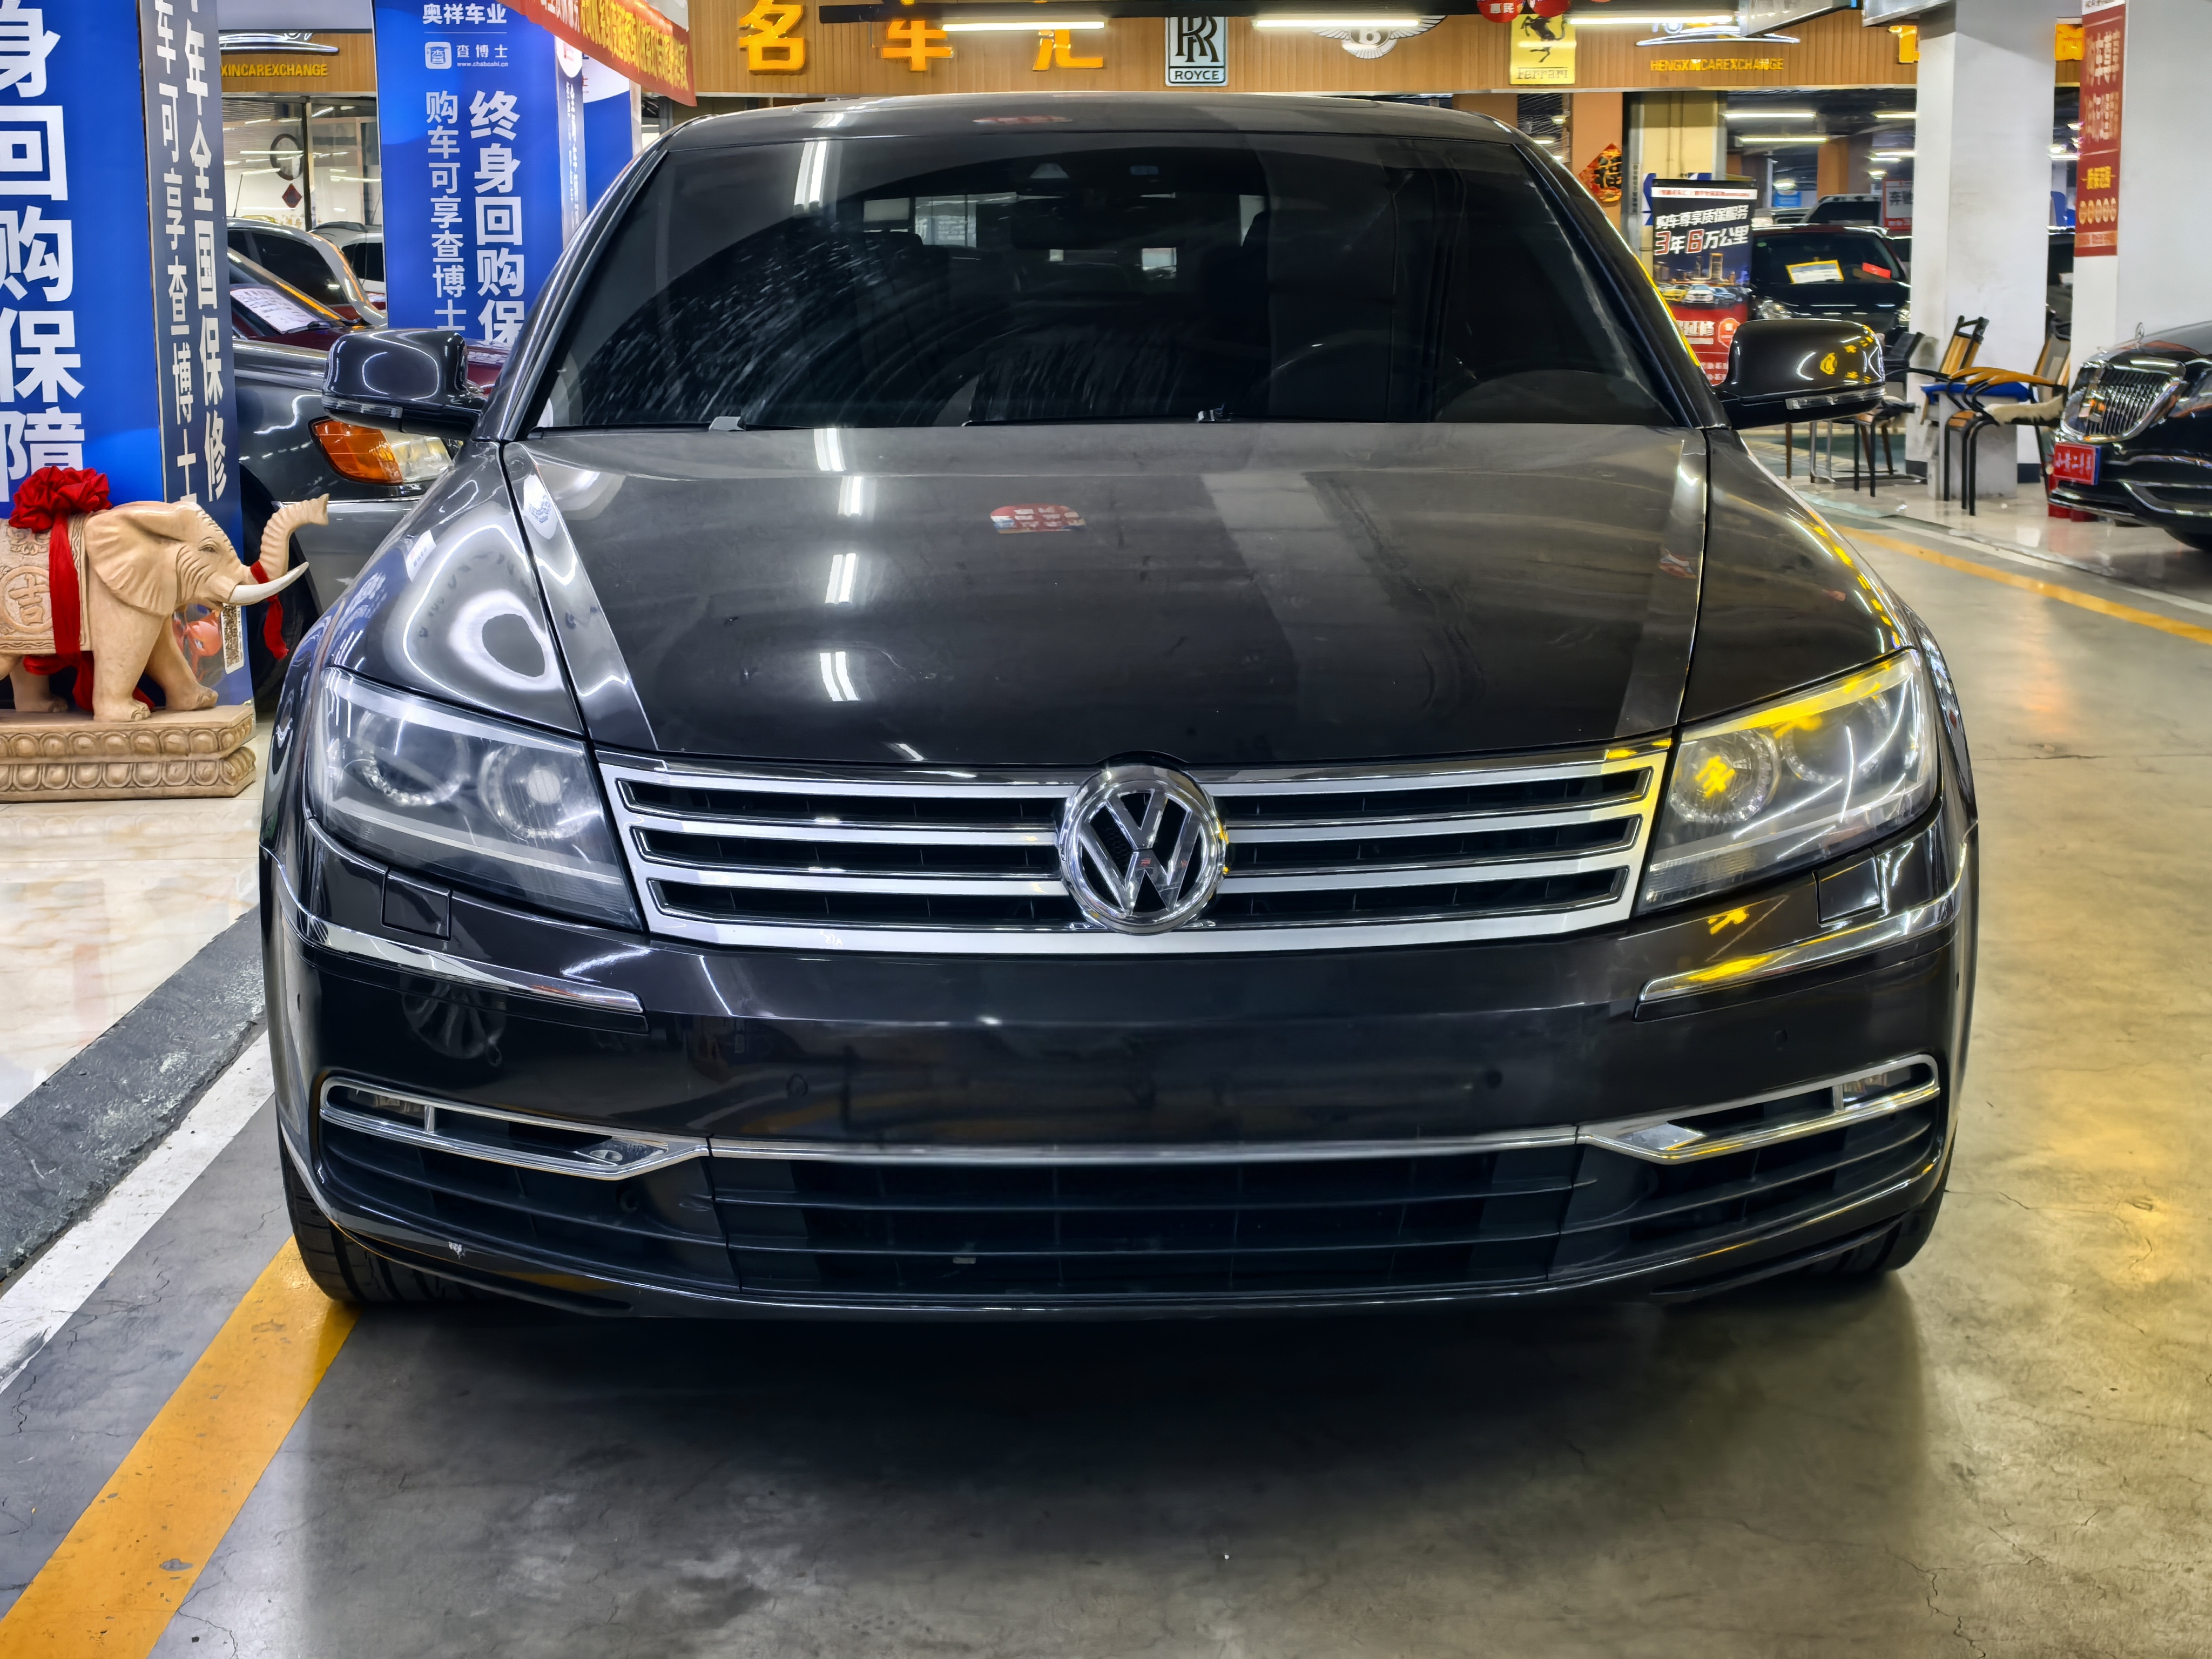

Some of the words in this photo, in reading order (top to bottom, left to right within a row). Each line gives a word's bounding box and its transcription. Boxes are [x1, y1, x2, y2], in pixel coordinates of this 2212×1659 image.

[422, 3, 507, 24] 奥祥车业
[456, 44, 508, 58] 查博士
[1175, 70, 1220, 80] ROYCE
[1516, 66, 1568, 79] Ferrari
[1650, 58, 1784, 71] HENGXINCAREXCHANGE
[425, 90, 467, 331] 购车可享查博士
[469, 90, 525, 346] 终身回购保
[1655, 204, 1750, 230] 购车尊享质保服务
[185, 0, 227, 502] 年全国保修
[1654, 224, 1750, 256] 3年6万公里
